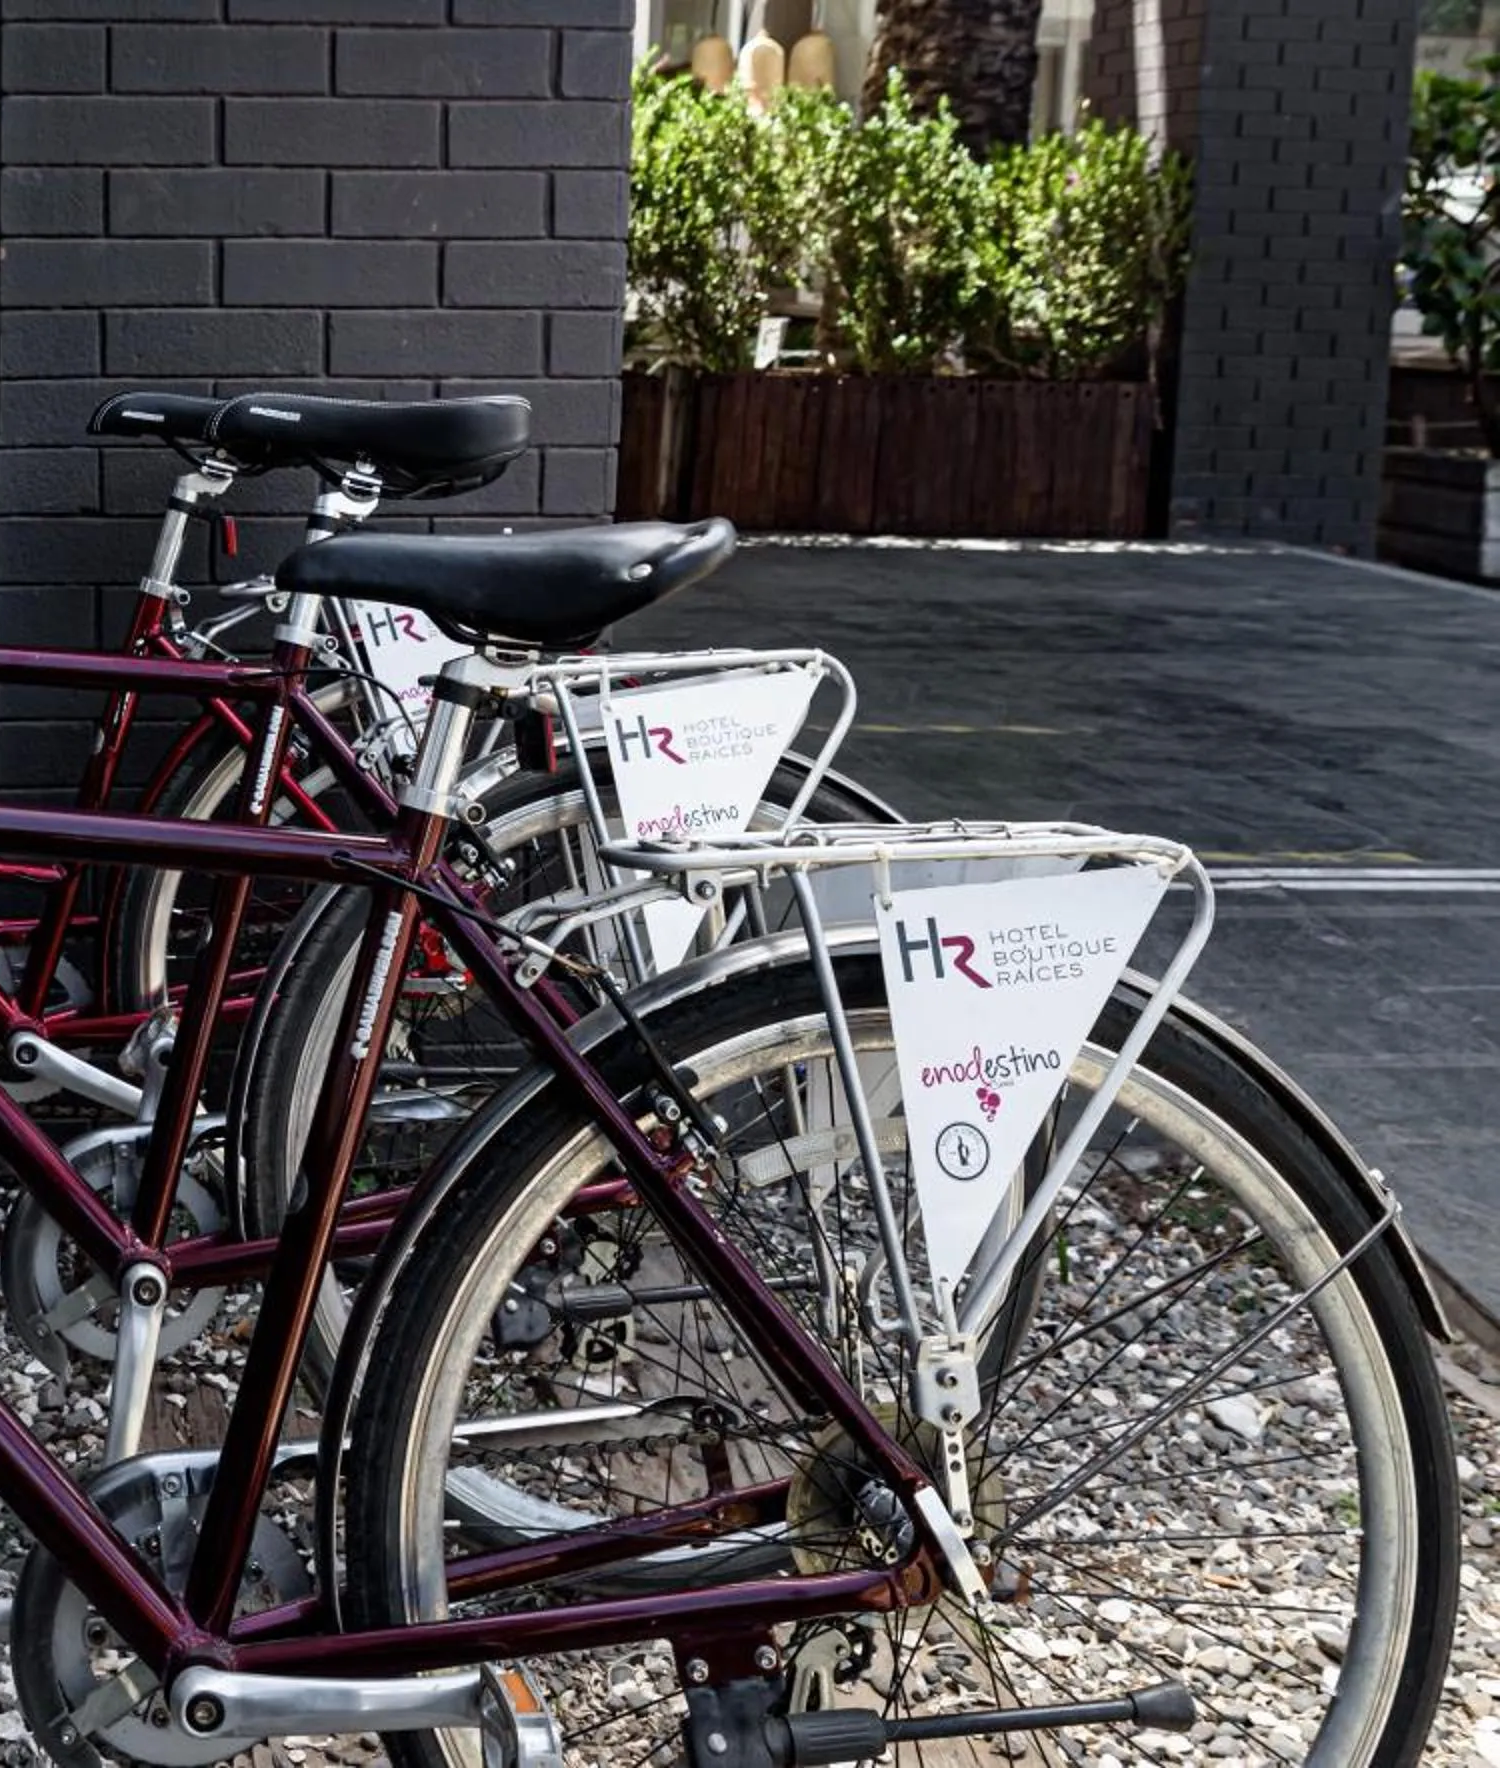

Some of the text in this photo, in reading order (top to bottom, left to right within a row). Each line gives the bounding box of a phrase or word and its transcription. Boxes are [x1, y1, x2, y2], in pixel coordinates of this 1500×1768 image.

[366, 607, 427, 646] HR
[615, 715, 686, 764] HR
[683, 715, 741, 733] HOTEL
[686, 723, 778, 748] BOUTIQUE
[637, 803, 739, 836] enodestino
[989, 924, 1068, 945] HOTEL
[896, 917, 993, 988] HR
[994, 937, 1117, 967] BOUTIQUE
[922, 1045, 1060, 1088] enodestino
